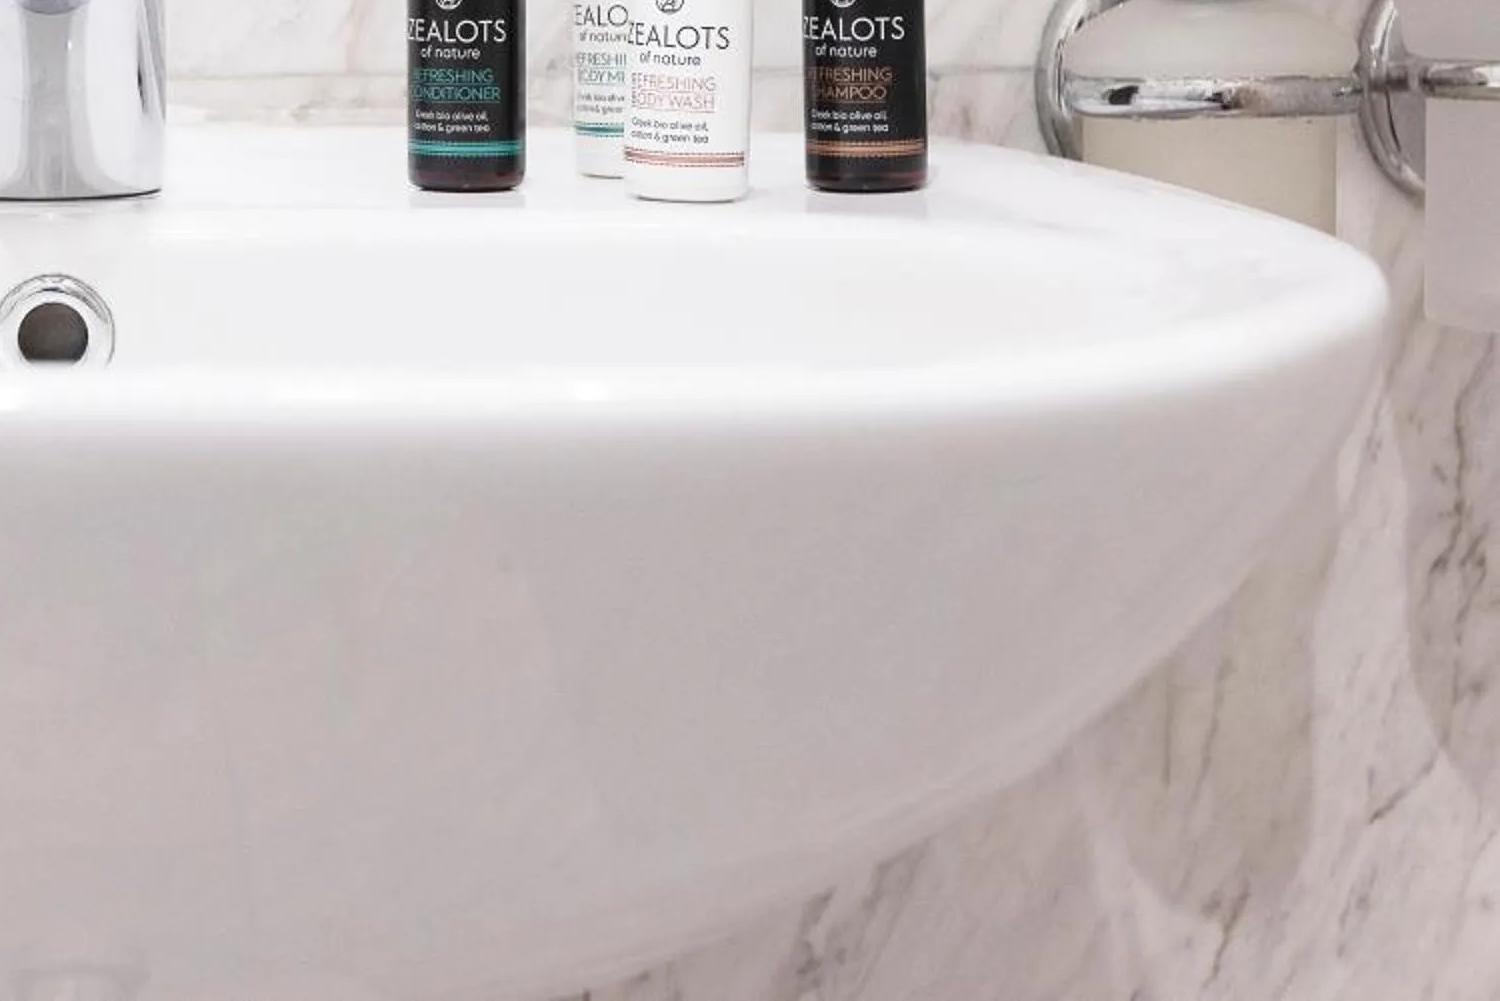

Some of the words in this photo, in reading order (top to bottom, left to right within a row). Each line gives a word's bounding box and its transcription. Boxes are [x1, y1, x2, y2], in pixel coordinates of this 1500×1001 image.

[574, 4, 628, 27] EALO
[407, 18, 507, 43] ZEALOTS
[628, 22, 730, 49] ZEALOTS
[803, 16, 905, 41] ZEALOTS
[589, 32, 627, 42] natur
[421, 44, 433, 58] of
[435, 47, 481, 60] nature
[815, 43, 826, 56] of
[829, 45, 877, 58] nature
[639, 51, 651, 63] of
[653, 53, 701, 66] nature
[811, 86, 887, 100] HAMPOO
[668, 94, 715, 109] WASH
